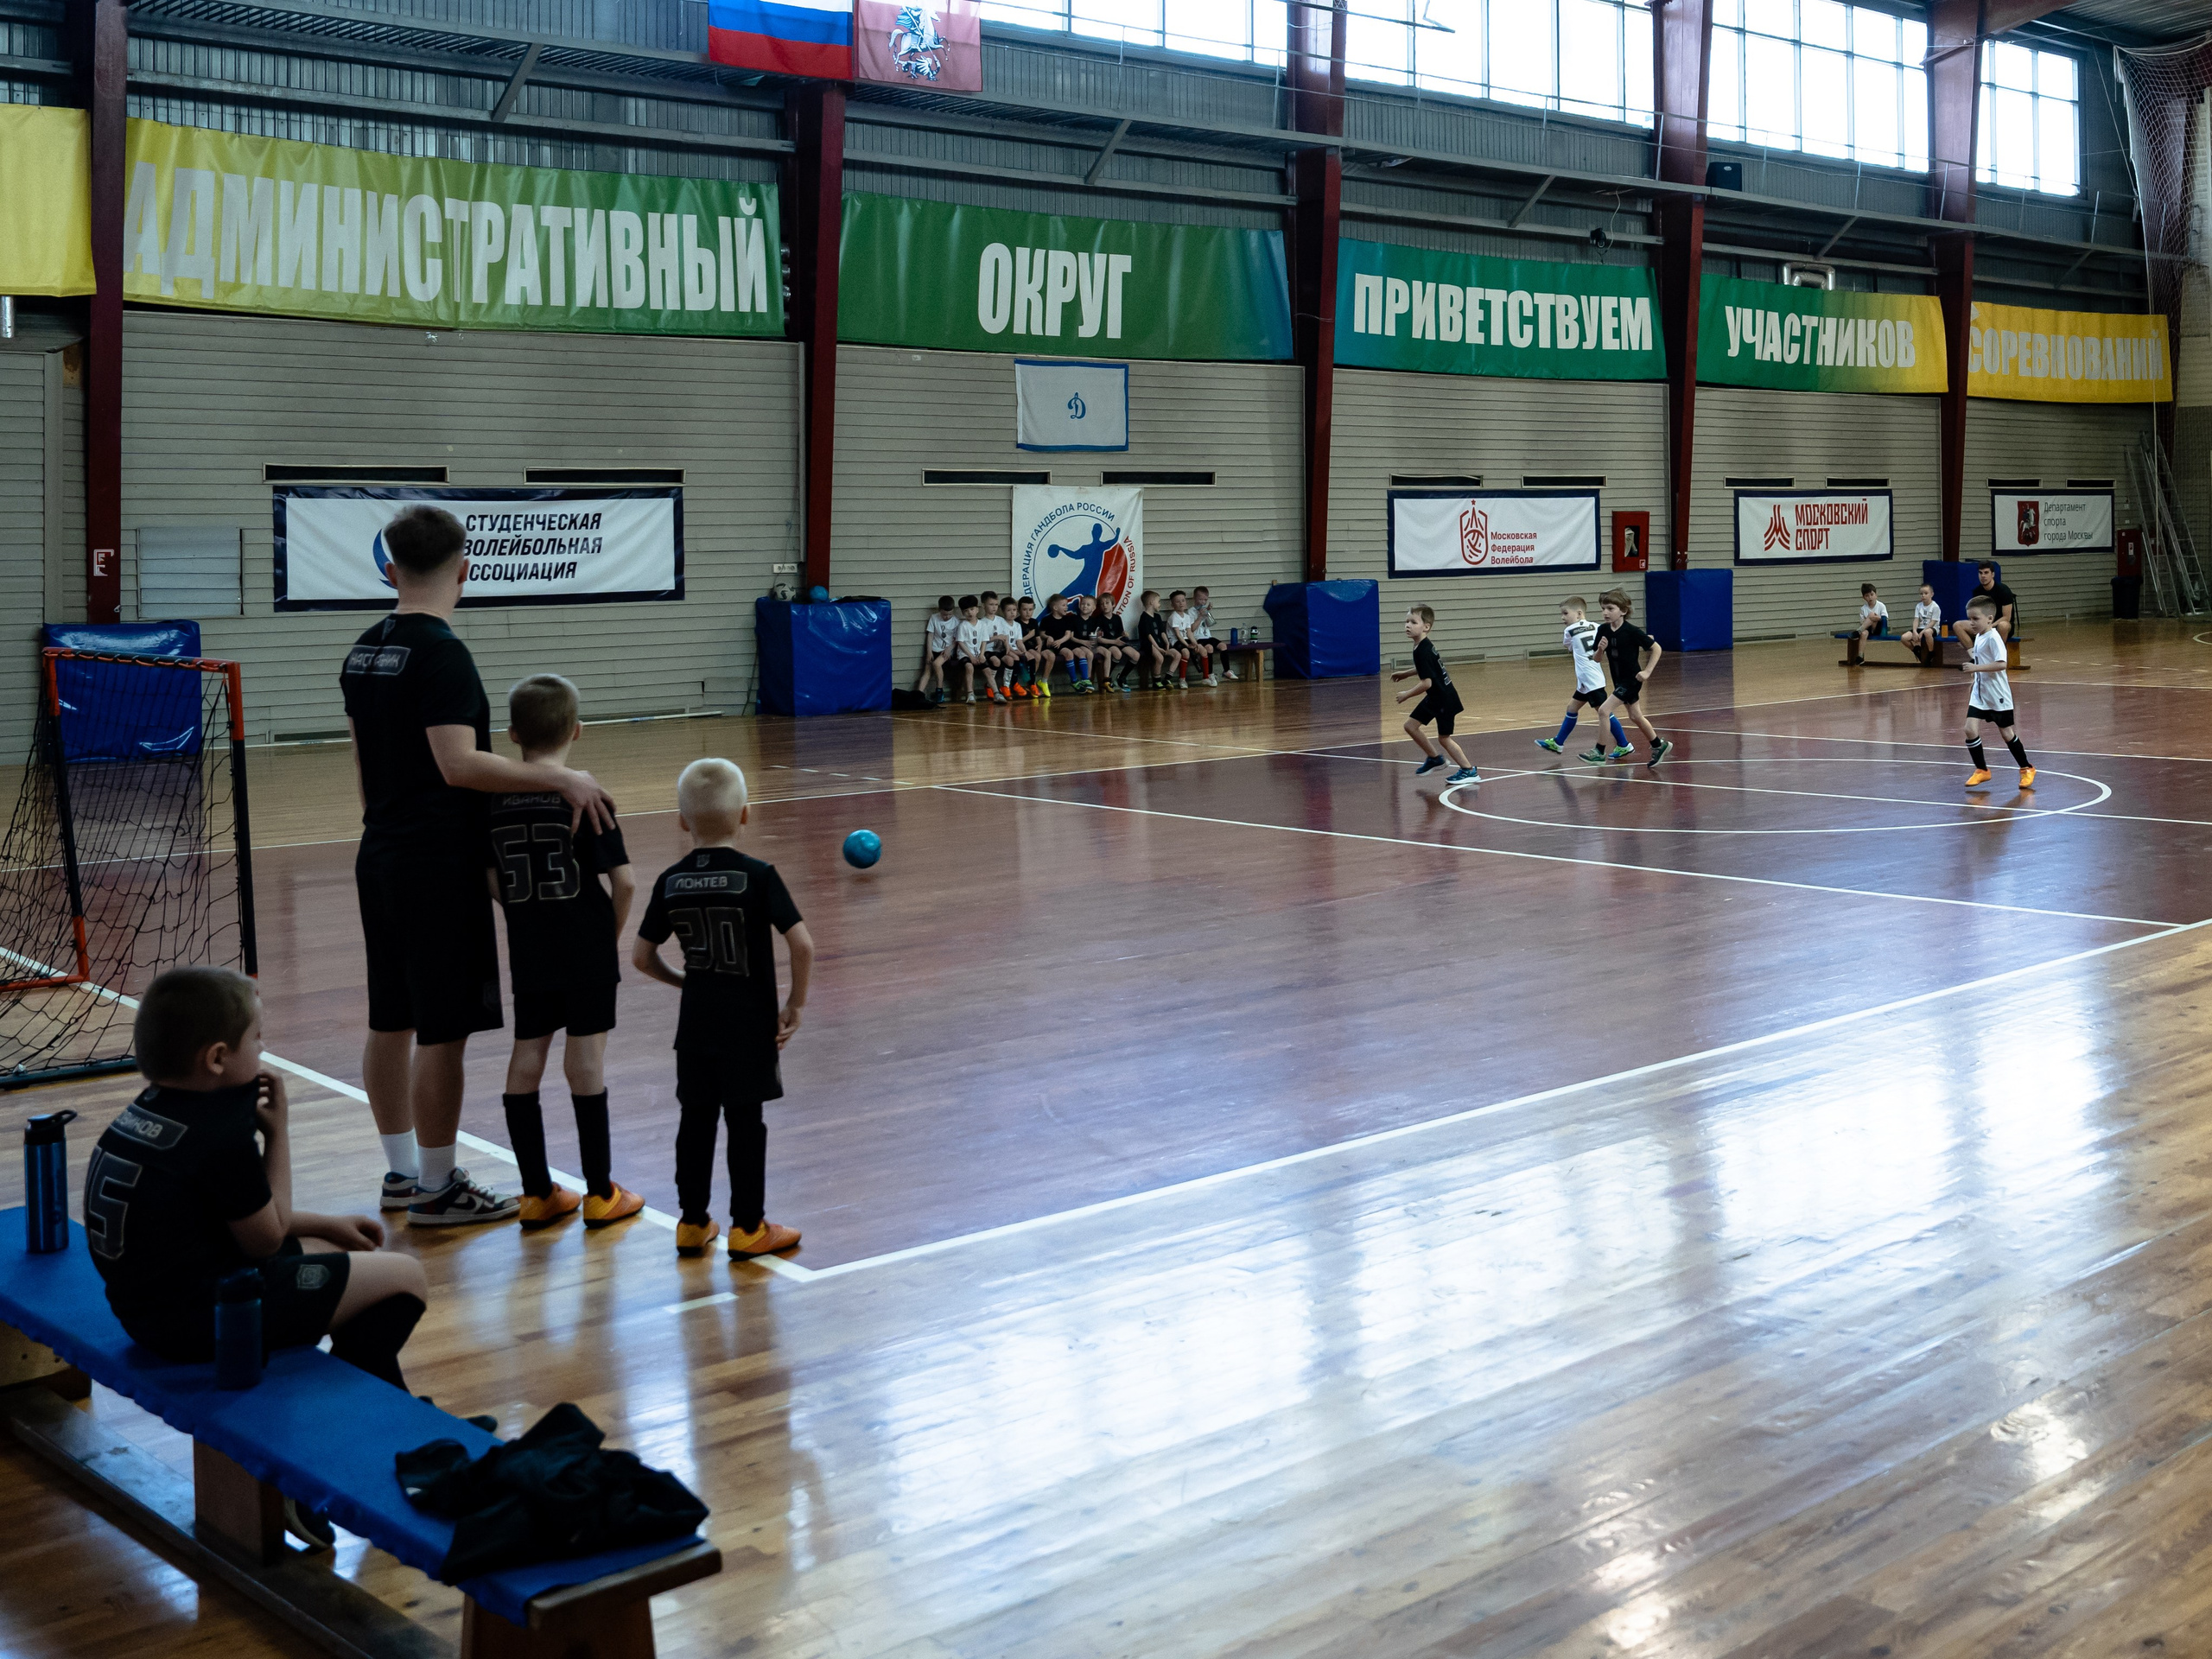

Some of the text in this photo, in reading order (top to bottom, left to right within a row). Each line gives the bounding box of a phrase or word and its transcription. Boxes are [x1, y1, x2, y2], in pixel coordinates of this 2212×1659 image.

[124, 161, 767, 313] АДМИНИСТРАТИВНЫЙ
[977, 243, 1132, 339] ОКРУГ
[1354, 272, 1653, 352] ПРИВЕТСТВУЕМ
[1725, 305, 1916, 368] УЧАСТНИКОВ
[1968, 326, 2164, 380] СОРЕВНОВАНИЙ
[1795, 498, 1868, 526] МОСКОВСКИЙ
[2044, 501, 2086, 514] Департамент
[466, 513, 602, 533] СТУДЕНЧЕСКАЯ
[1032, 503, 1074, 541] ГАНДБОЛА
[1077, 502, 1116, 522] РОССИИ
[2044, 518, 2067, 529] спорта
[464, 534, 603, 556] ВОЛЕЙБОЛЬНАЯ
[1491, 531, 1537, 540] Московская
[1796, 528, 1830, 550] СПОРТ
[2044, 530, 2094, 543] города Москвы
[1123, 536, 1136, 572] RUSSIA
[1491, 543, 1535, 554] Федерация
[1491, 554, 1534, 565] Волейбола
[465, 562, 577, 582] ССОЦИАЦИЯ
[1127, 576, 1135, 588] OF
[491, 823, 581, 903] 53
[675, 876, 728, 890] ЛОКТЕВ
